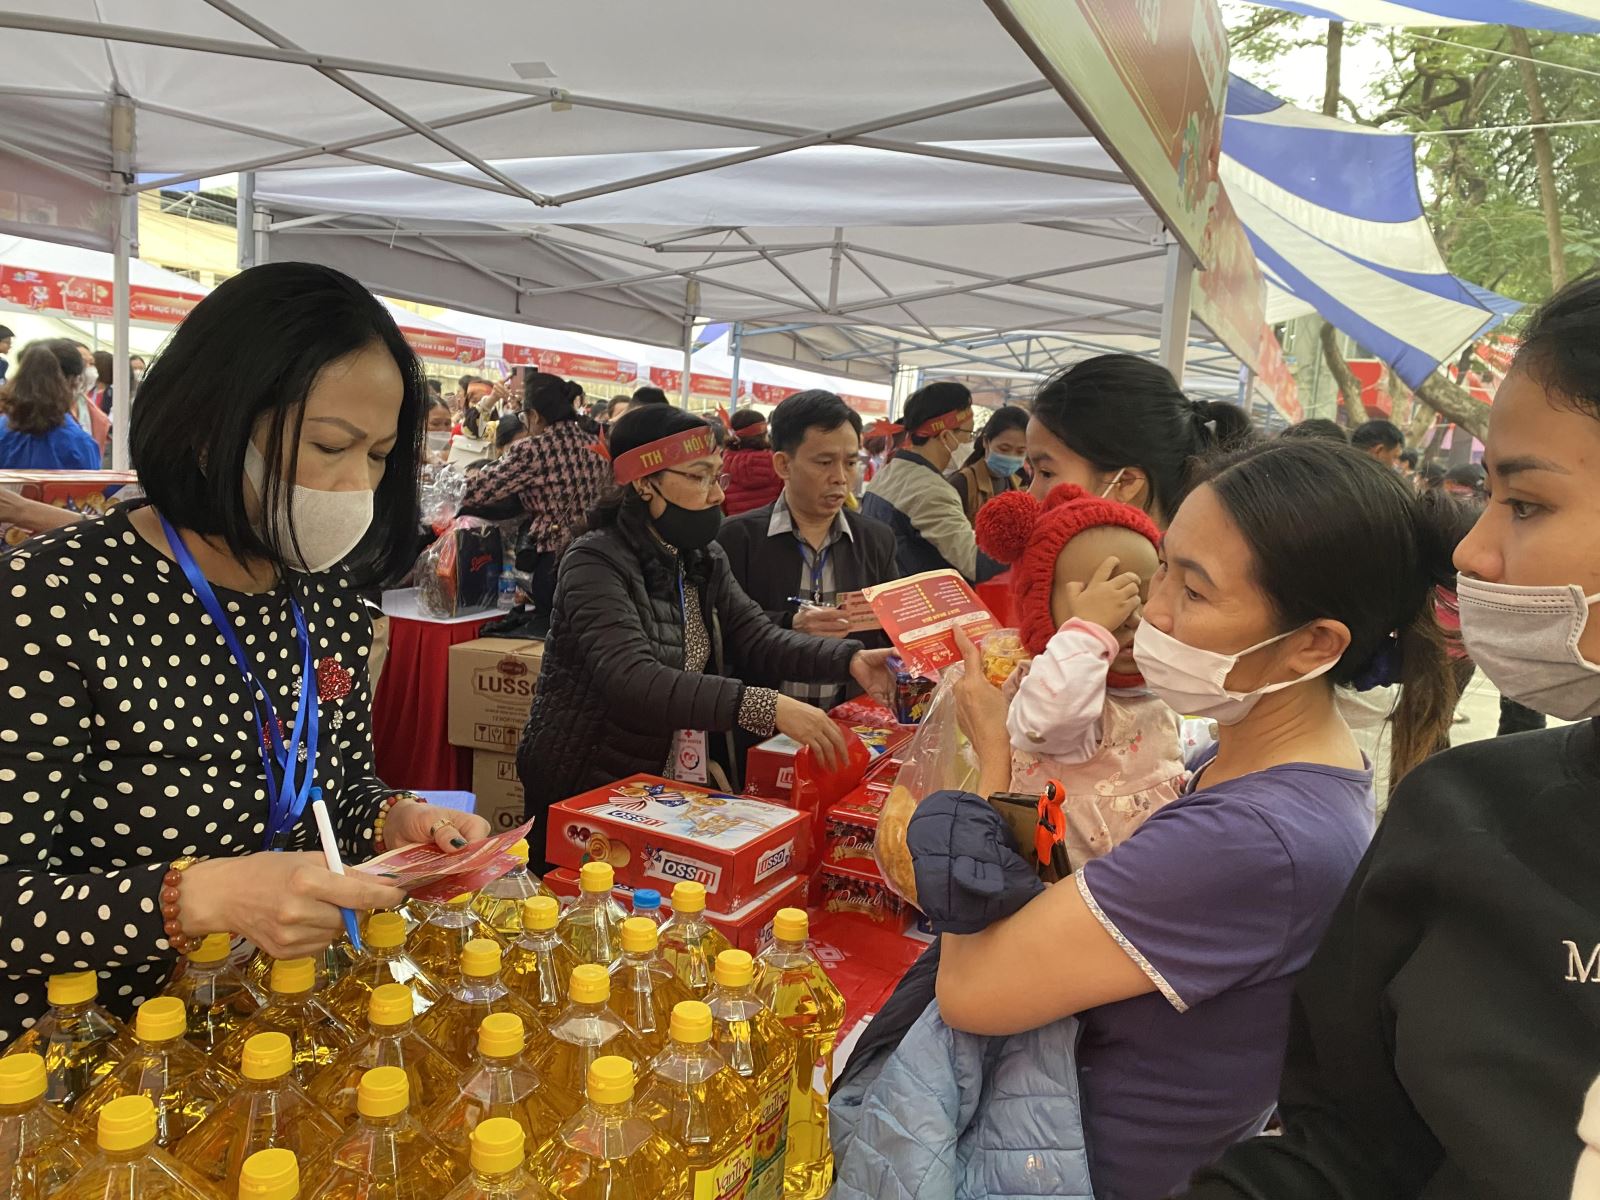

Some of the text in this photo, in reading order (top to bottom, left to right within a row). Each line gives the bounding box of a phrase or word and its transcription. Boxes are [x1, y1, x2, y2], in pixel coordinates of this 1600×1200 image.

[640, 451, 663, 468] TTH
[683, 435, 704, 454] HỘI
[611, 811, 666, 827] LUSSO
[664, 861, 716, 886] LUSSO
[758, 851, 784, 874] LUSSO
[836, 889, 883, 905] Daniel
